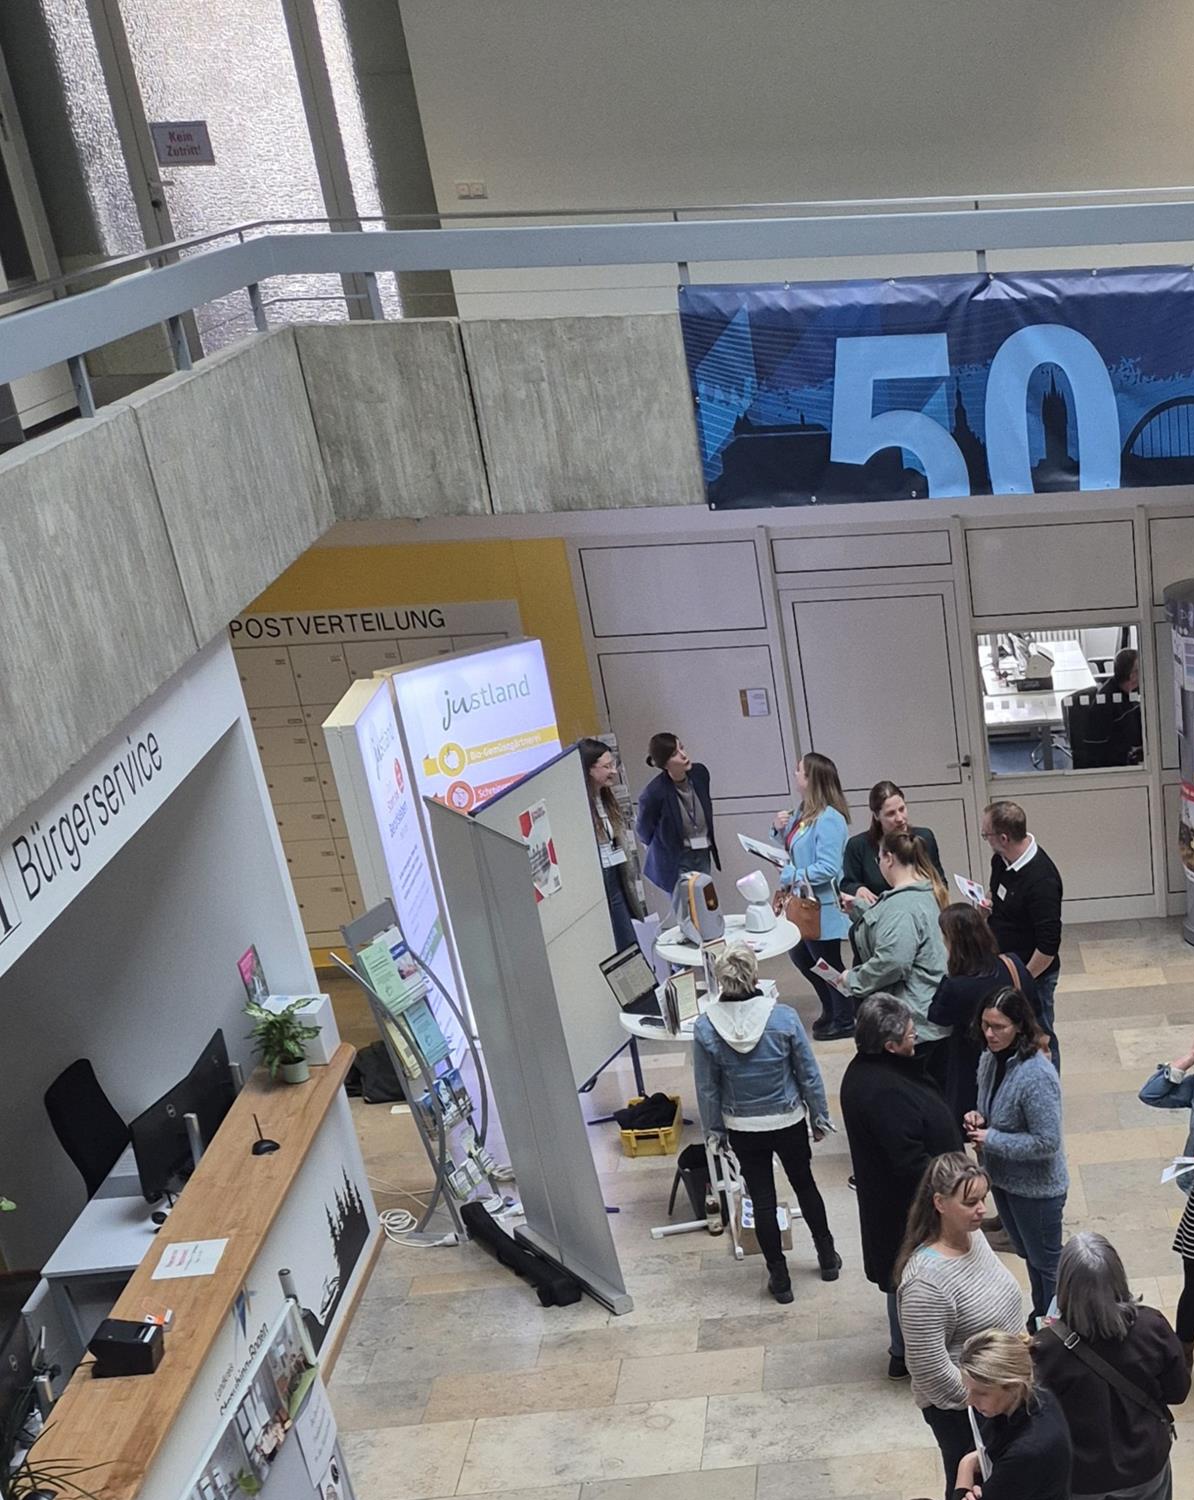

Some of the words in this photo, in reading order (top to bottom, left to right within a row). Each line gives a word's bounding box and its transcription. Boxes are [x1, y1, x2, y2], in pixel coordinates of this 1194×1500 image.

[166, 144, 201, 157] Zutritt!
[168, 130, 194, 144] Kein
[830, 324, 1121, 499] 50
[228, 608, 446, 640] POSTVERTEILUNG
[442, 673, 531, 731] justland
[12, 731, 162, 901] Bürgerservice
